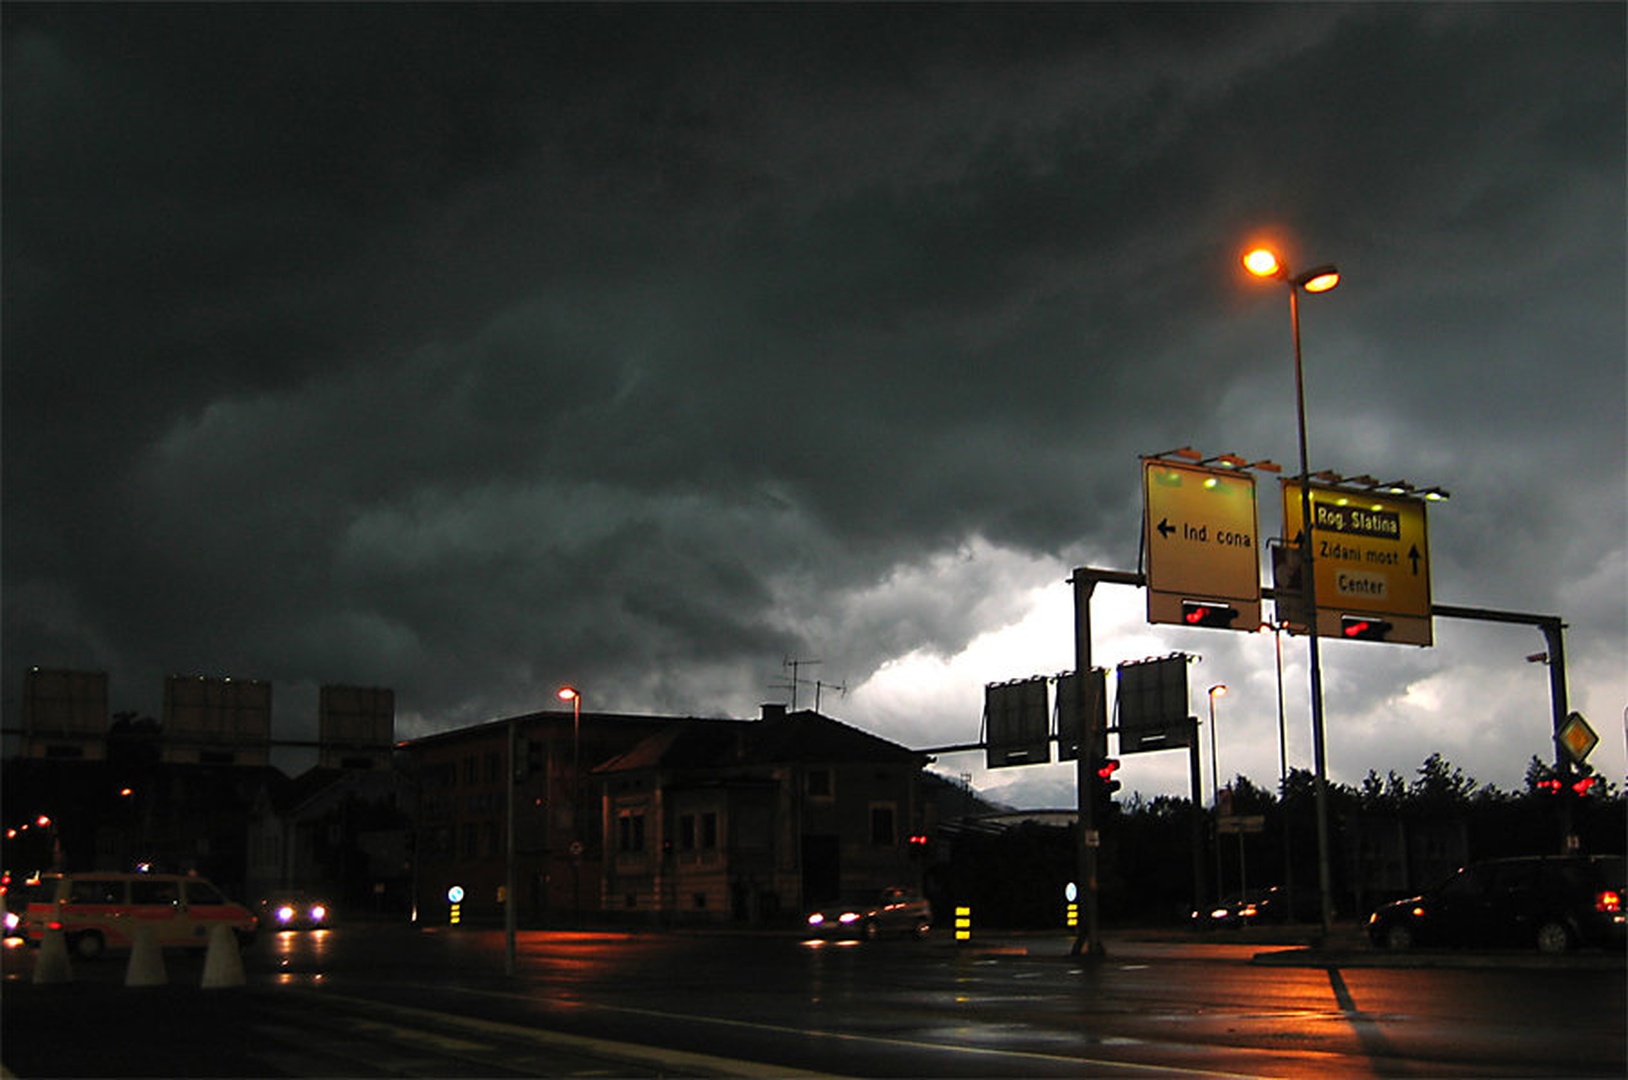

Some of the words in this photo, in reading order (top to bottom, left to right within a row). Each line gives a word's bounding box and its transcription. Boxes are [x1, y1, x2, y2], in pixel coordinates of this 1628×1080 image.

[1317, 506, 1347, 531] Rog.
[1351, 510, 1398, 534] Slatina
[1216, 530, 1252, 547] cona
[1320, 540, 1361, 561] Zidani
[1366, 549, 1399, 566] most
[1338, 573, 1383, 595] Center
